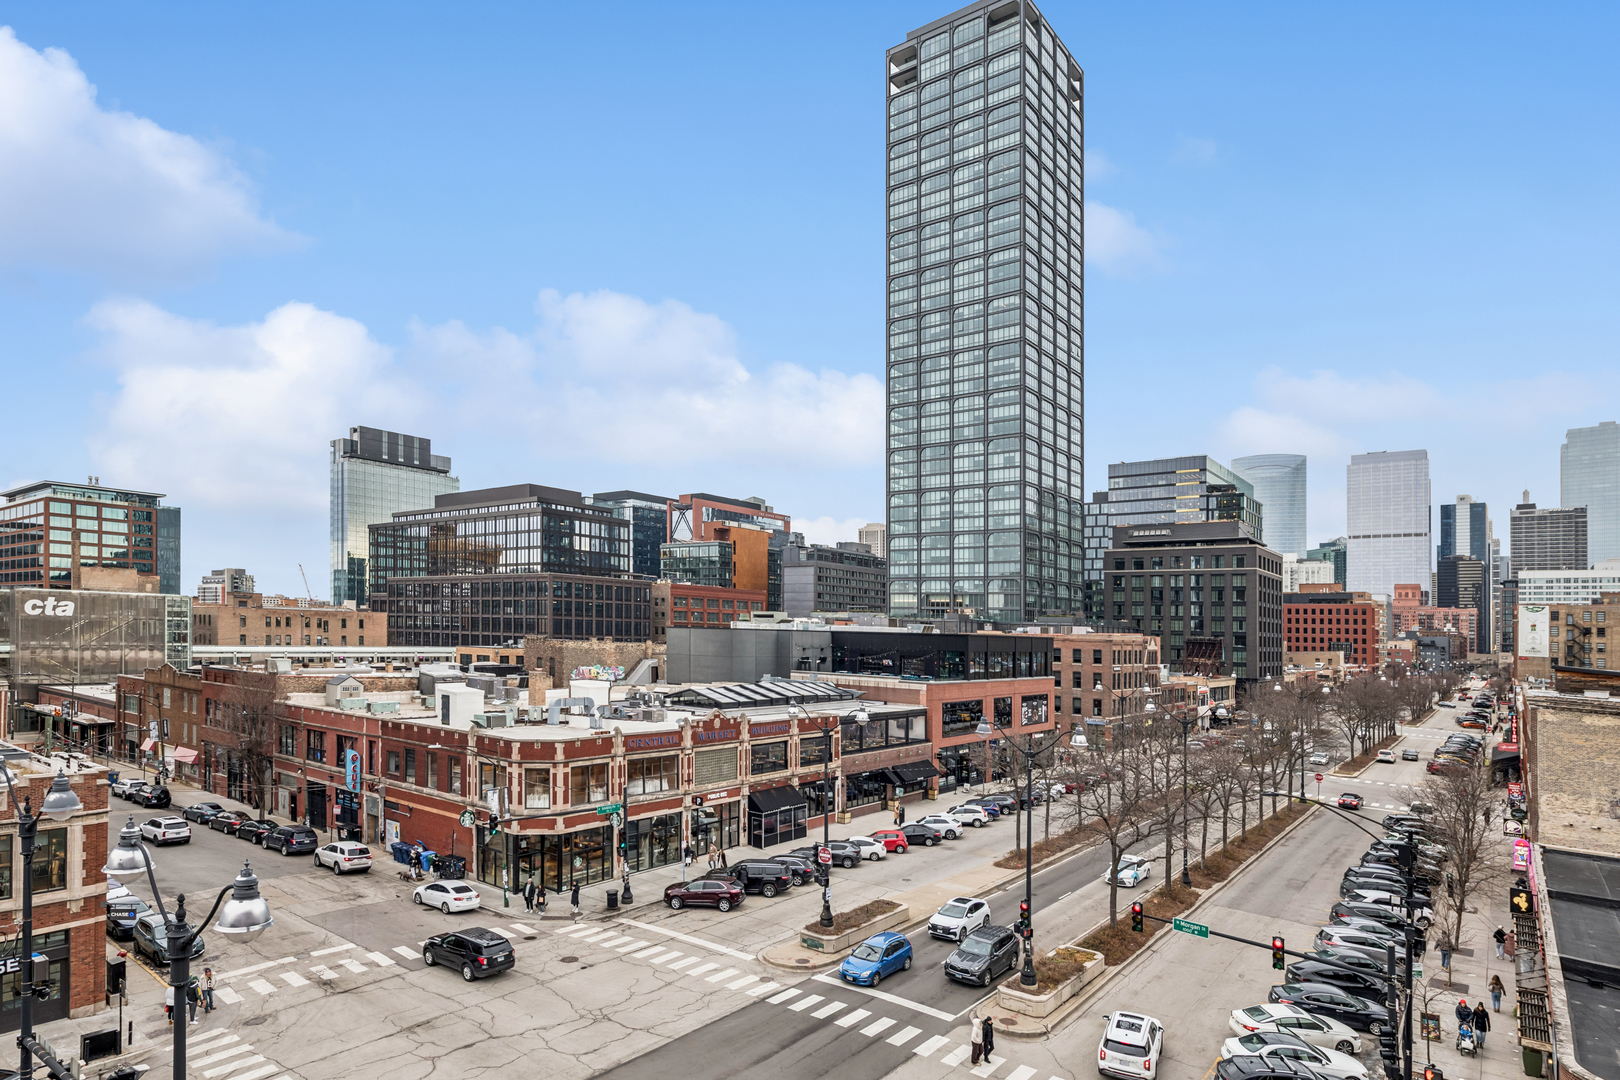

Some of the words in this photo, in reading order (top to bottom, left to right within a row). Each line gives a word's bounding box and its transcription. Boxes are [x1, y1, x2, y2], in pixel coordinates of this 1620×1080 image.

[24, 596, 75, 617] cta
[628, 735, 680, 748] CENTRAL
[698, 729, 736, 741] MARKET
[752, 724, 789, 736] BUILDING
[1180, 920, 1201, 931] Morgan
